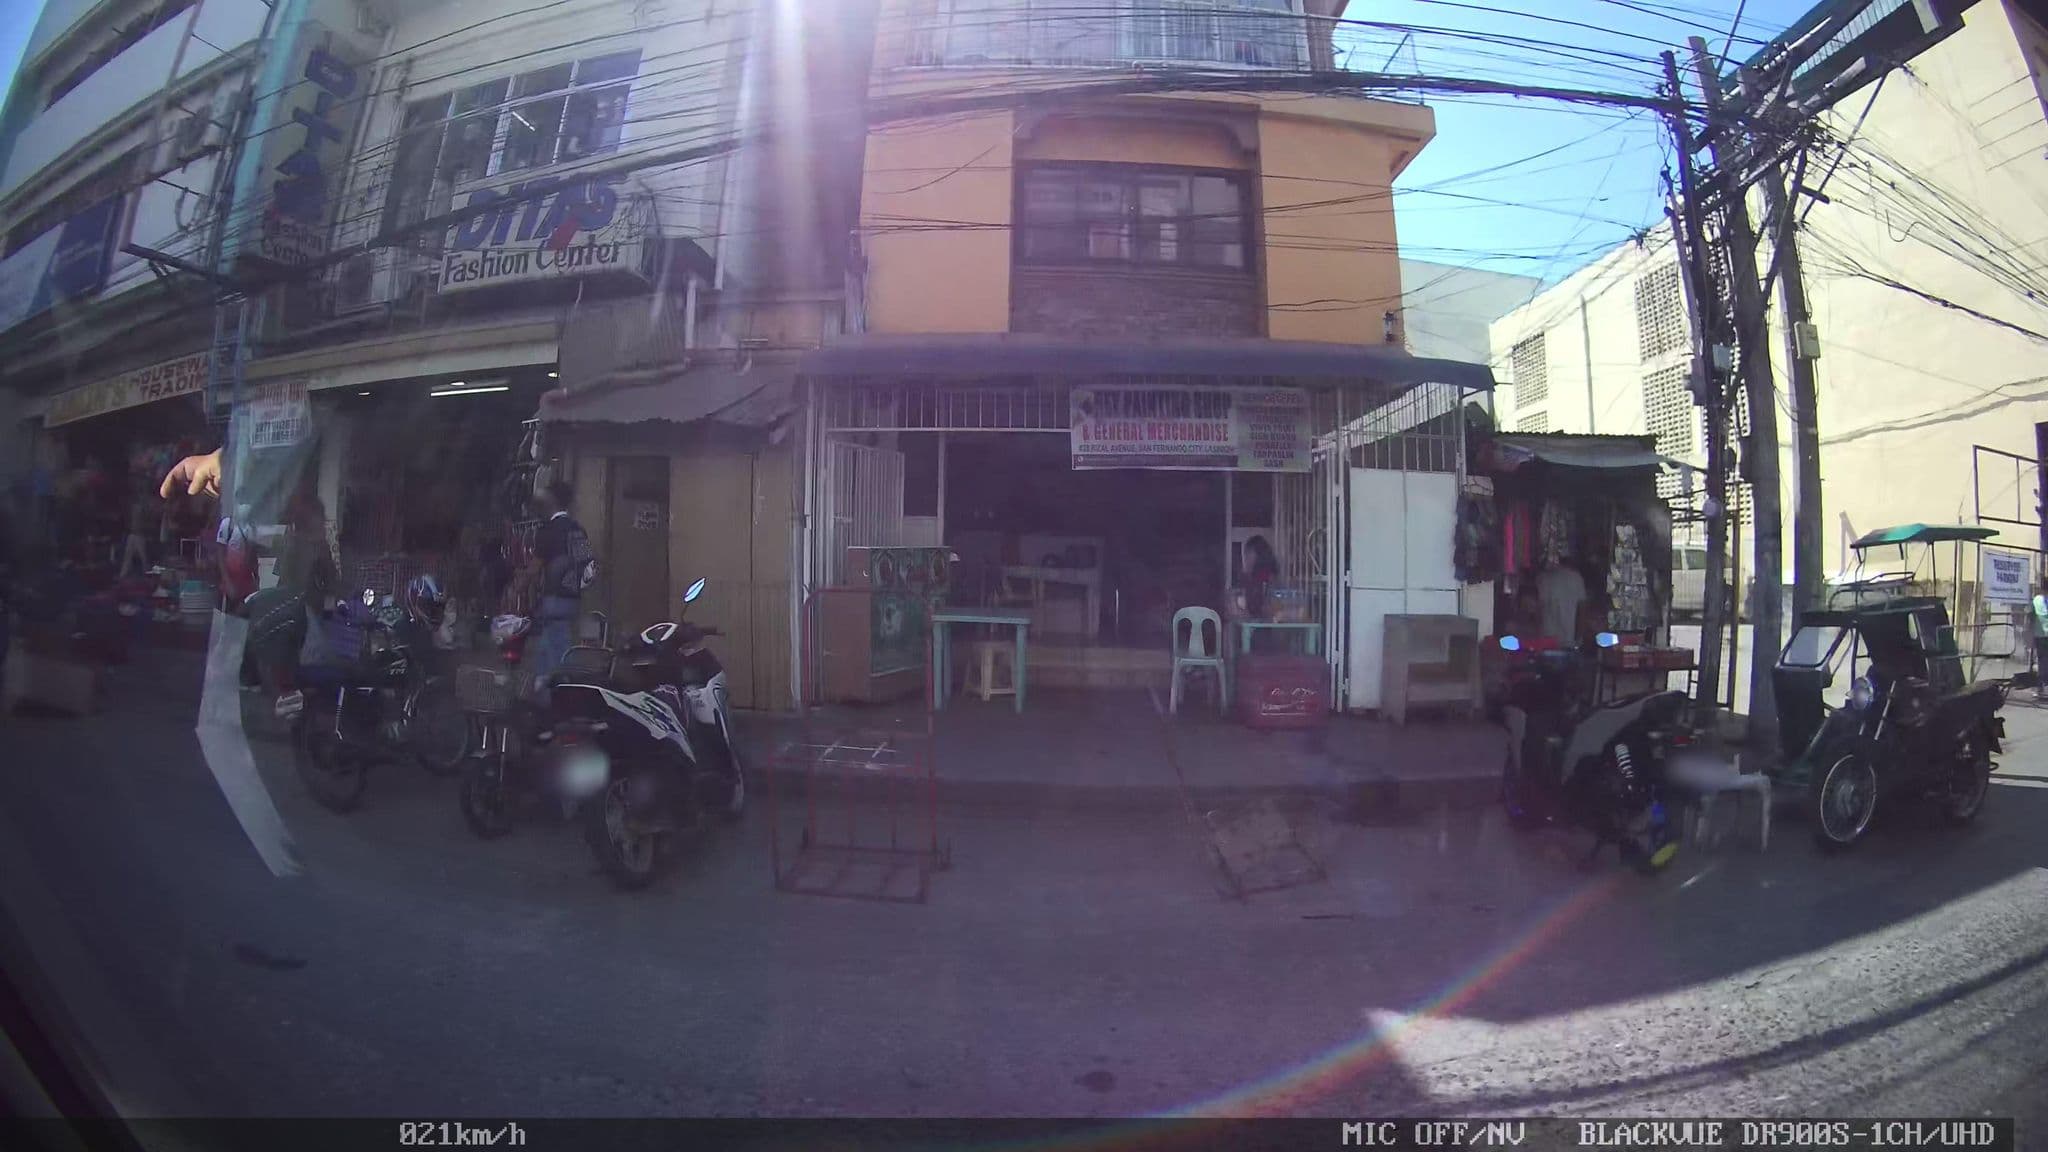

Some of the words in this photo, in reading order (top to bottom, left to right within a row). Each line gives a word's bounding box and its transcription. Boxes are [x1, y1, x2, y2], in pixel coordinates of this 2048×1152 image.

[441, 249, 529, 286] Fashion
[536, 235, 621, 271] Center
[1094, 423, 1144, 441] GENERAL
[1147, 422, 1229, 442] MERCHANDISE
